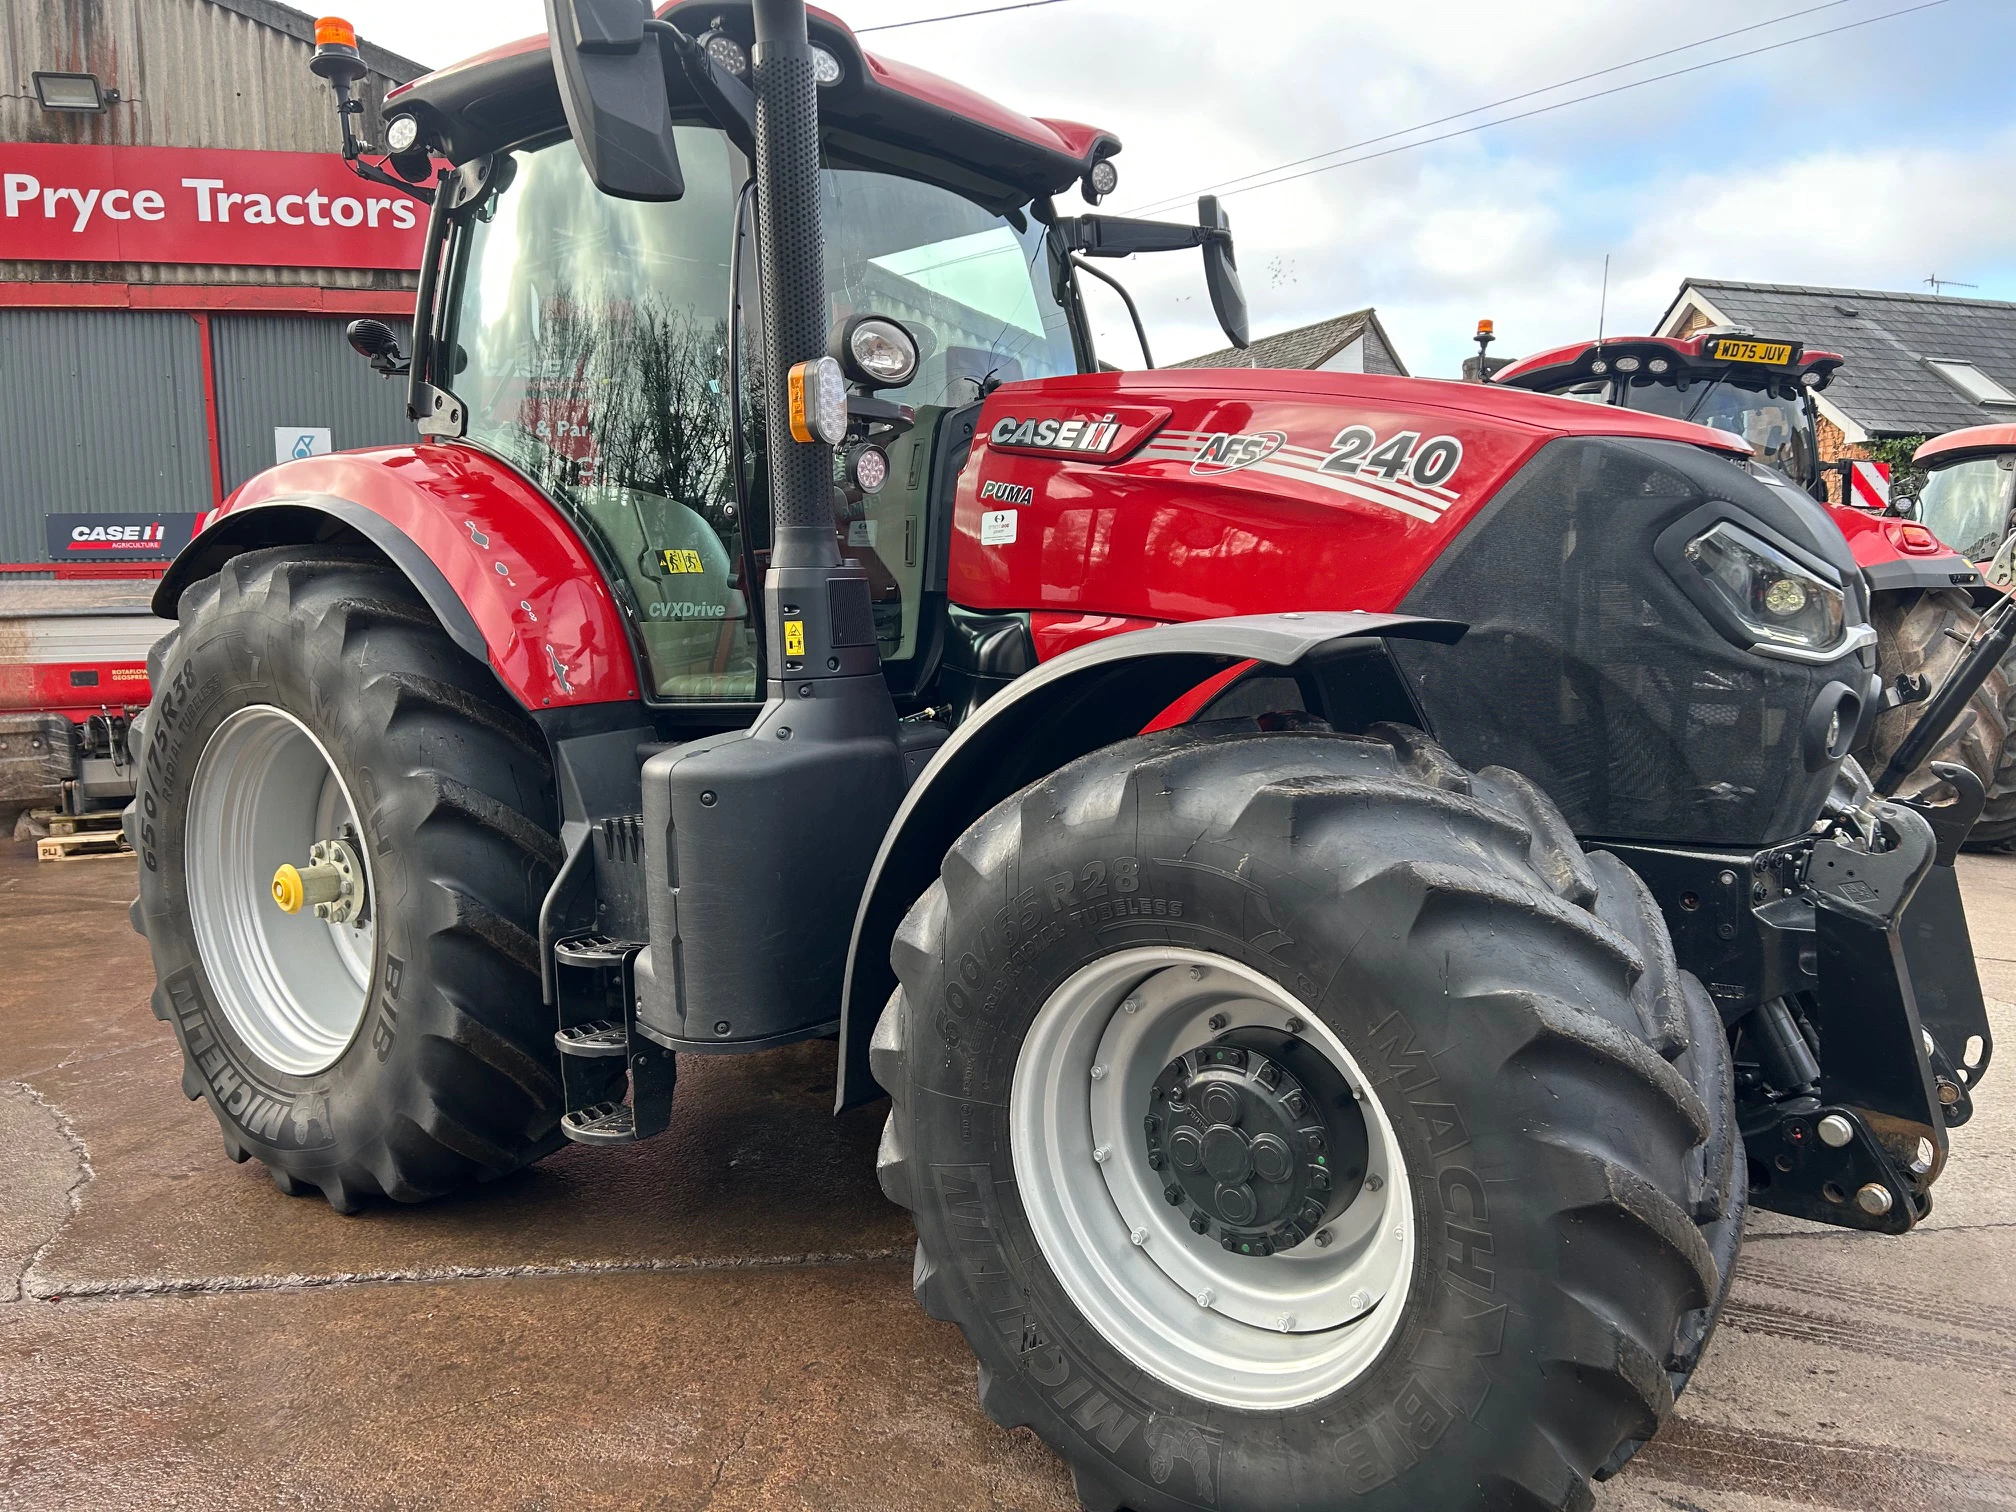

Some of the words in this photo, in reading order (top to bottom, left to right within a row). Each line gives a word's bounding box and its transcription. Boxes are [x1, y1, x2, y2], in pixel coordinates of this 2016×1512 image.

[3, 173, 165, 233] Pryce
[181, 178, 416, 229] Tractors
[1721, 342, 1757, 359] WD75
[1759, 345, 1785, 361] JUV
[991, 416, 1083, 450] CASE
[1198, 432, 1270, 467] AFS
[1317, 424, 1464, 490] 240
[980, 480, 1033, 506] PUMA
[71, 526, 141, 541] CASE
[648, 601, 726, 618] CVXDrive
[162, 738, 184, 803] RADIAL
[177, 672, 222, 741] TUBELESS
[1000, 921, 1066, 982] RADIAL
[1069, 898, 1185, 928] TUBELESS
[164, 976, 292, 1142] MICHELIN
[939, 1172, 1141, 1454] MICHELIN
